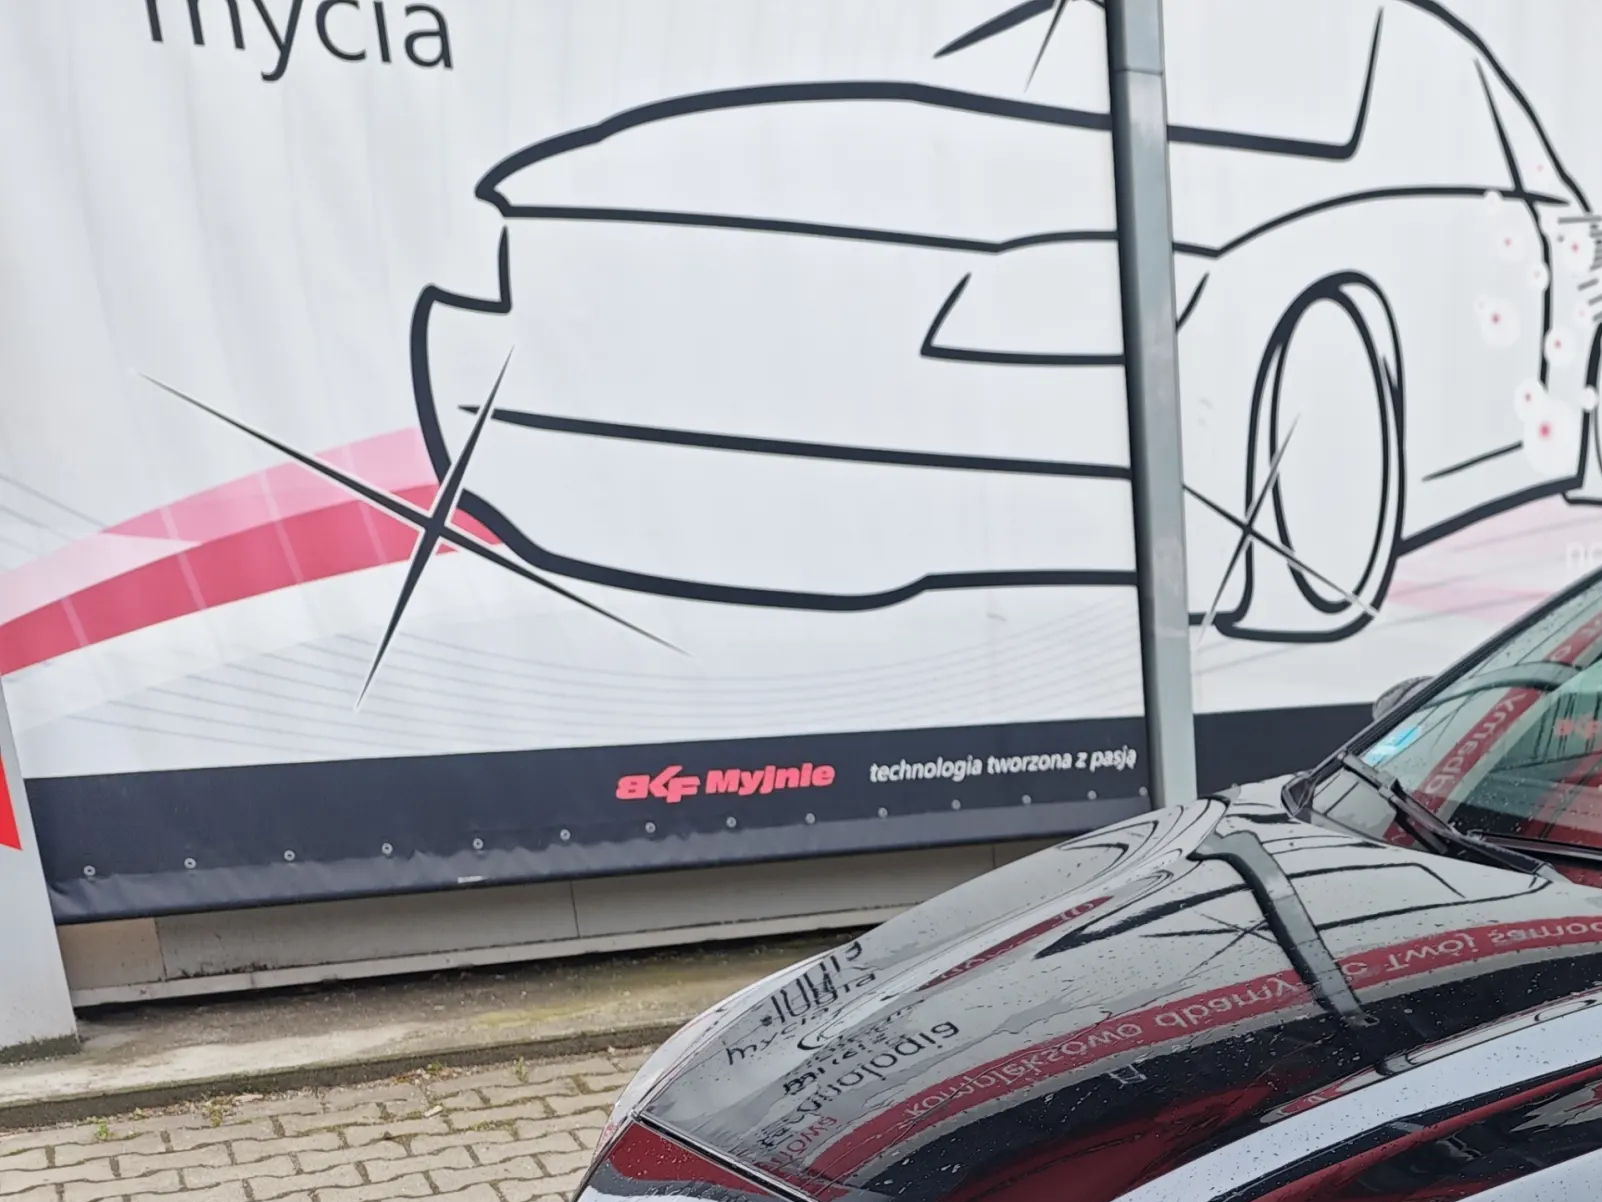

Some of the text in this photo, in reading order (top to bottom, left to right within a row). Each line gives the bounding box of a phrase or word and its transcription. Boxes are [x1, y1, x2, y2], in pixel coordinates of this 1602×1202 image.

[145, 0, 454, 82] mycia
[705, 762, 836, 796] Myjnie
[869, 744, 1138, 783] technologia tworzona z pasją
